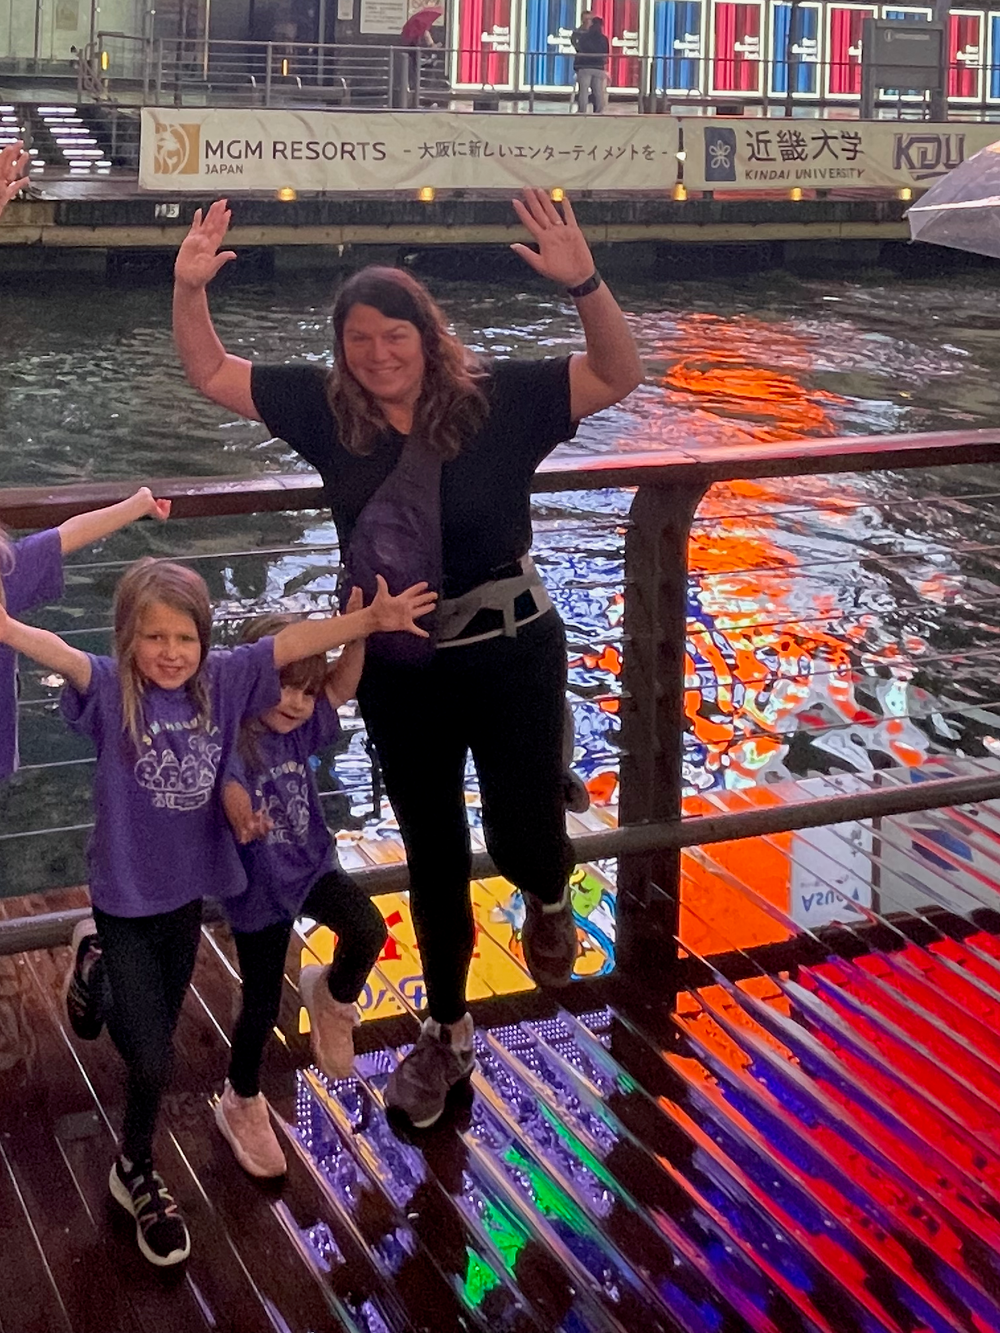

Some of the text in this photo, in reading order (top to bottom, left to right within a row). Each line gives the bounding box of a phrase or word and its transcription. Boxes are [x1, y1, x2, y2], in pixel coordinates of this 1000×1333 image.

[205, 139, 263, 160] MGM
[271, 140, 387, 161] RESORTS
[746, 128, 865, 163] 近畿大学
[204, 164, 243, 175] JAPAN
[745, 168, 866, 181] KINDAI UNIVERSITY
